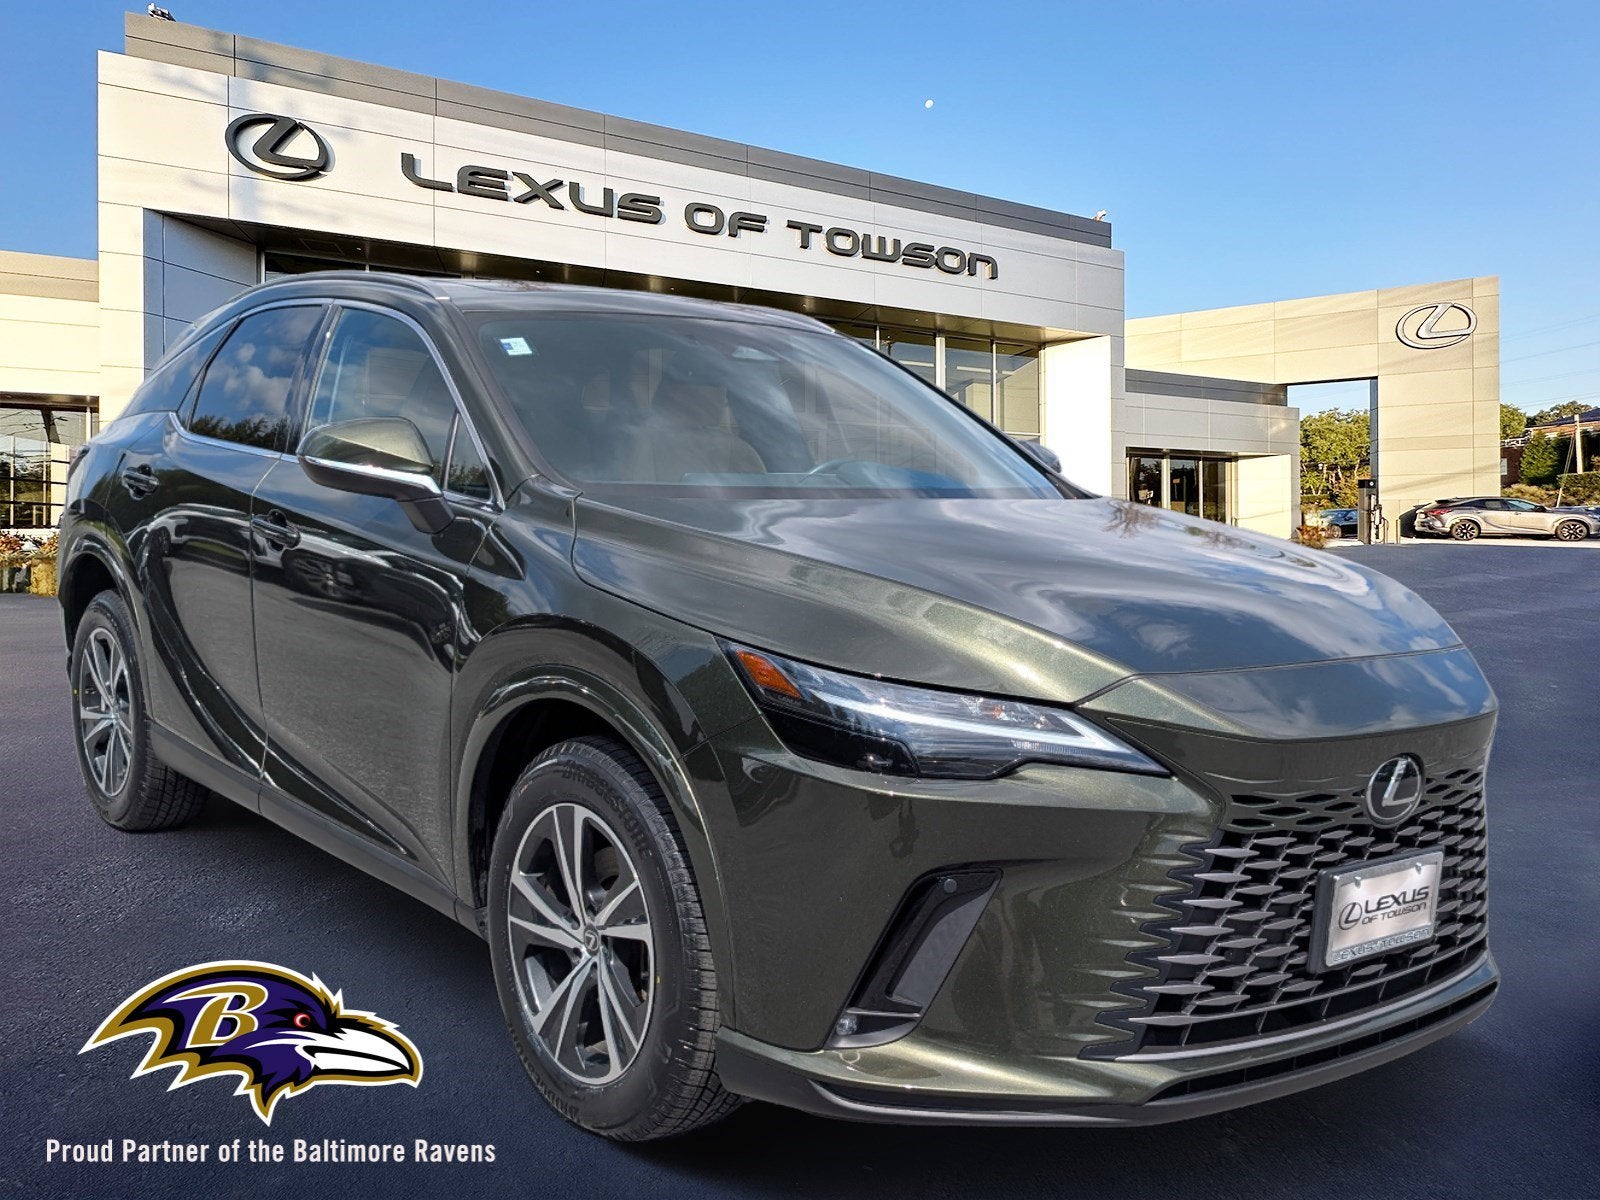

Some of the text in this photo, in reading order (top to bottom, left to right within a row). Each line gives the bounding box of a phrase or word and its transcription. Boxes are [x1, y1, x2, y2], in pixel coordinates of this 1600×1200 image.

[401, 152, 999, 280] LEXUS OF TOWSON
[1361, 902, 1427, 925] OF TOWSON
[1365, 885, 1430, 914] LEXUS
